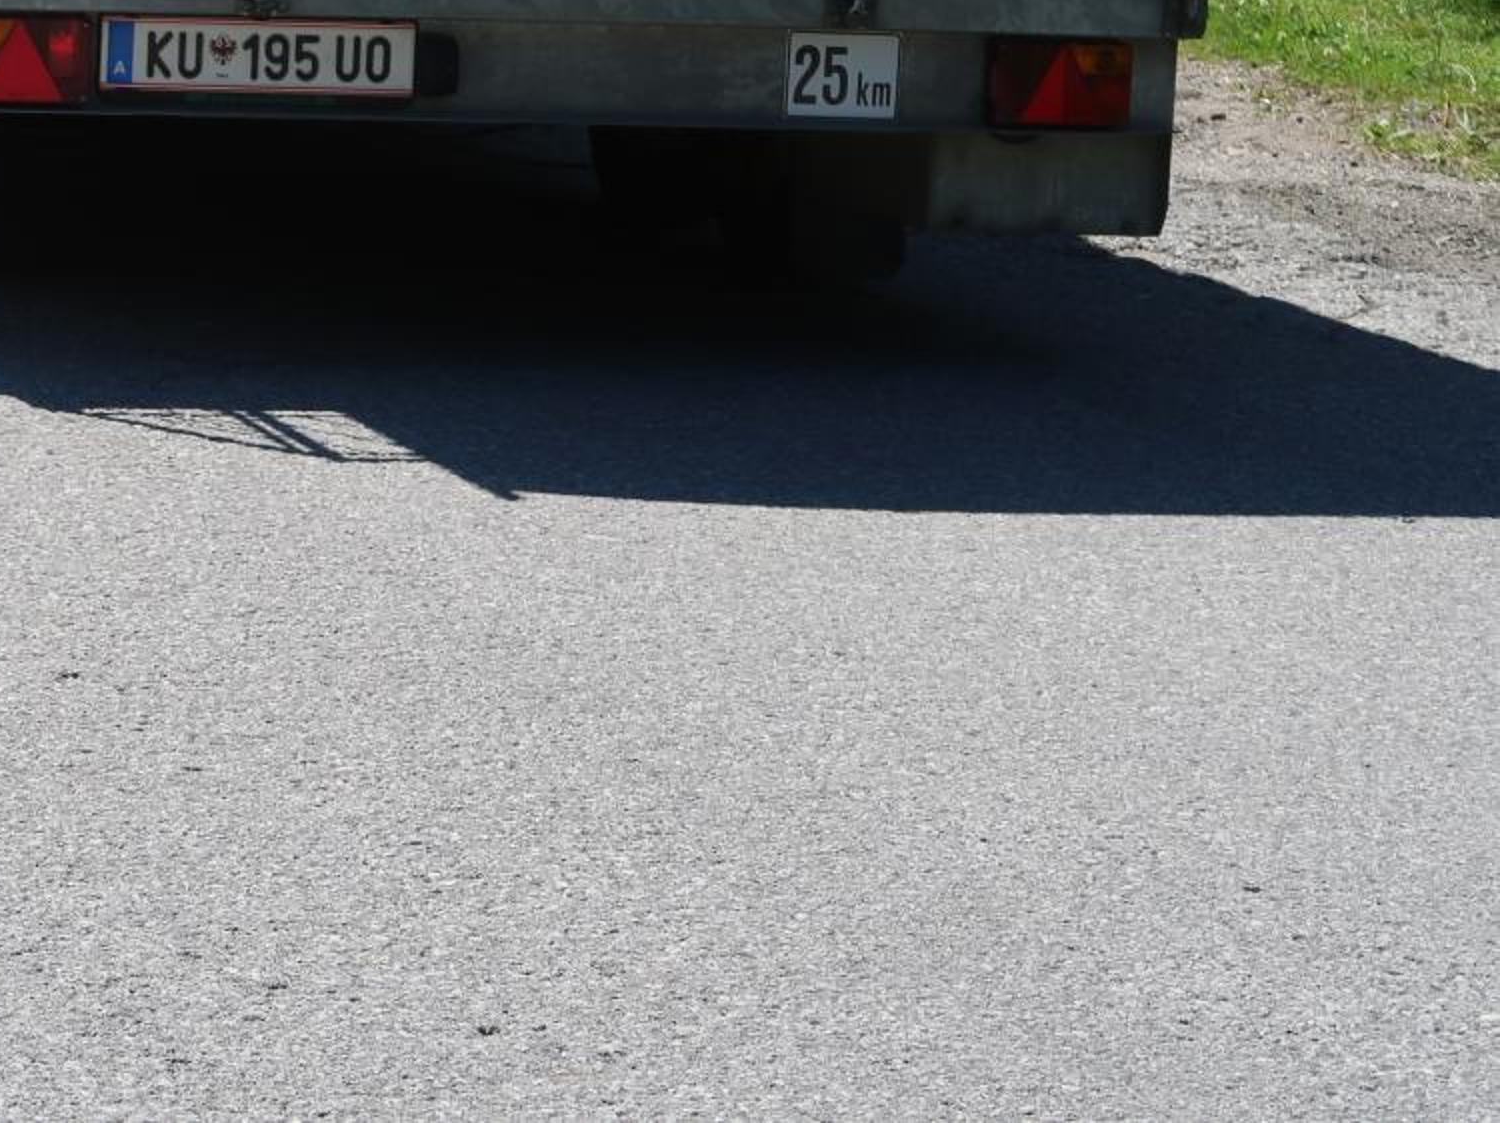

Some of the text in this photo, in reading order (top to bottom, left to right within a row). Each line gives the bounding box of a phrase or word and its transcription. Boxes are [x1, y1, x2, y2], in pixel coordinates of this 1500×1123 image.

[113, 60, 126, 75] A
[146, 30, 392, 84] KU 195 UO
[793, 44, 892, 108] 25 km
